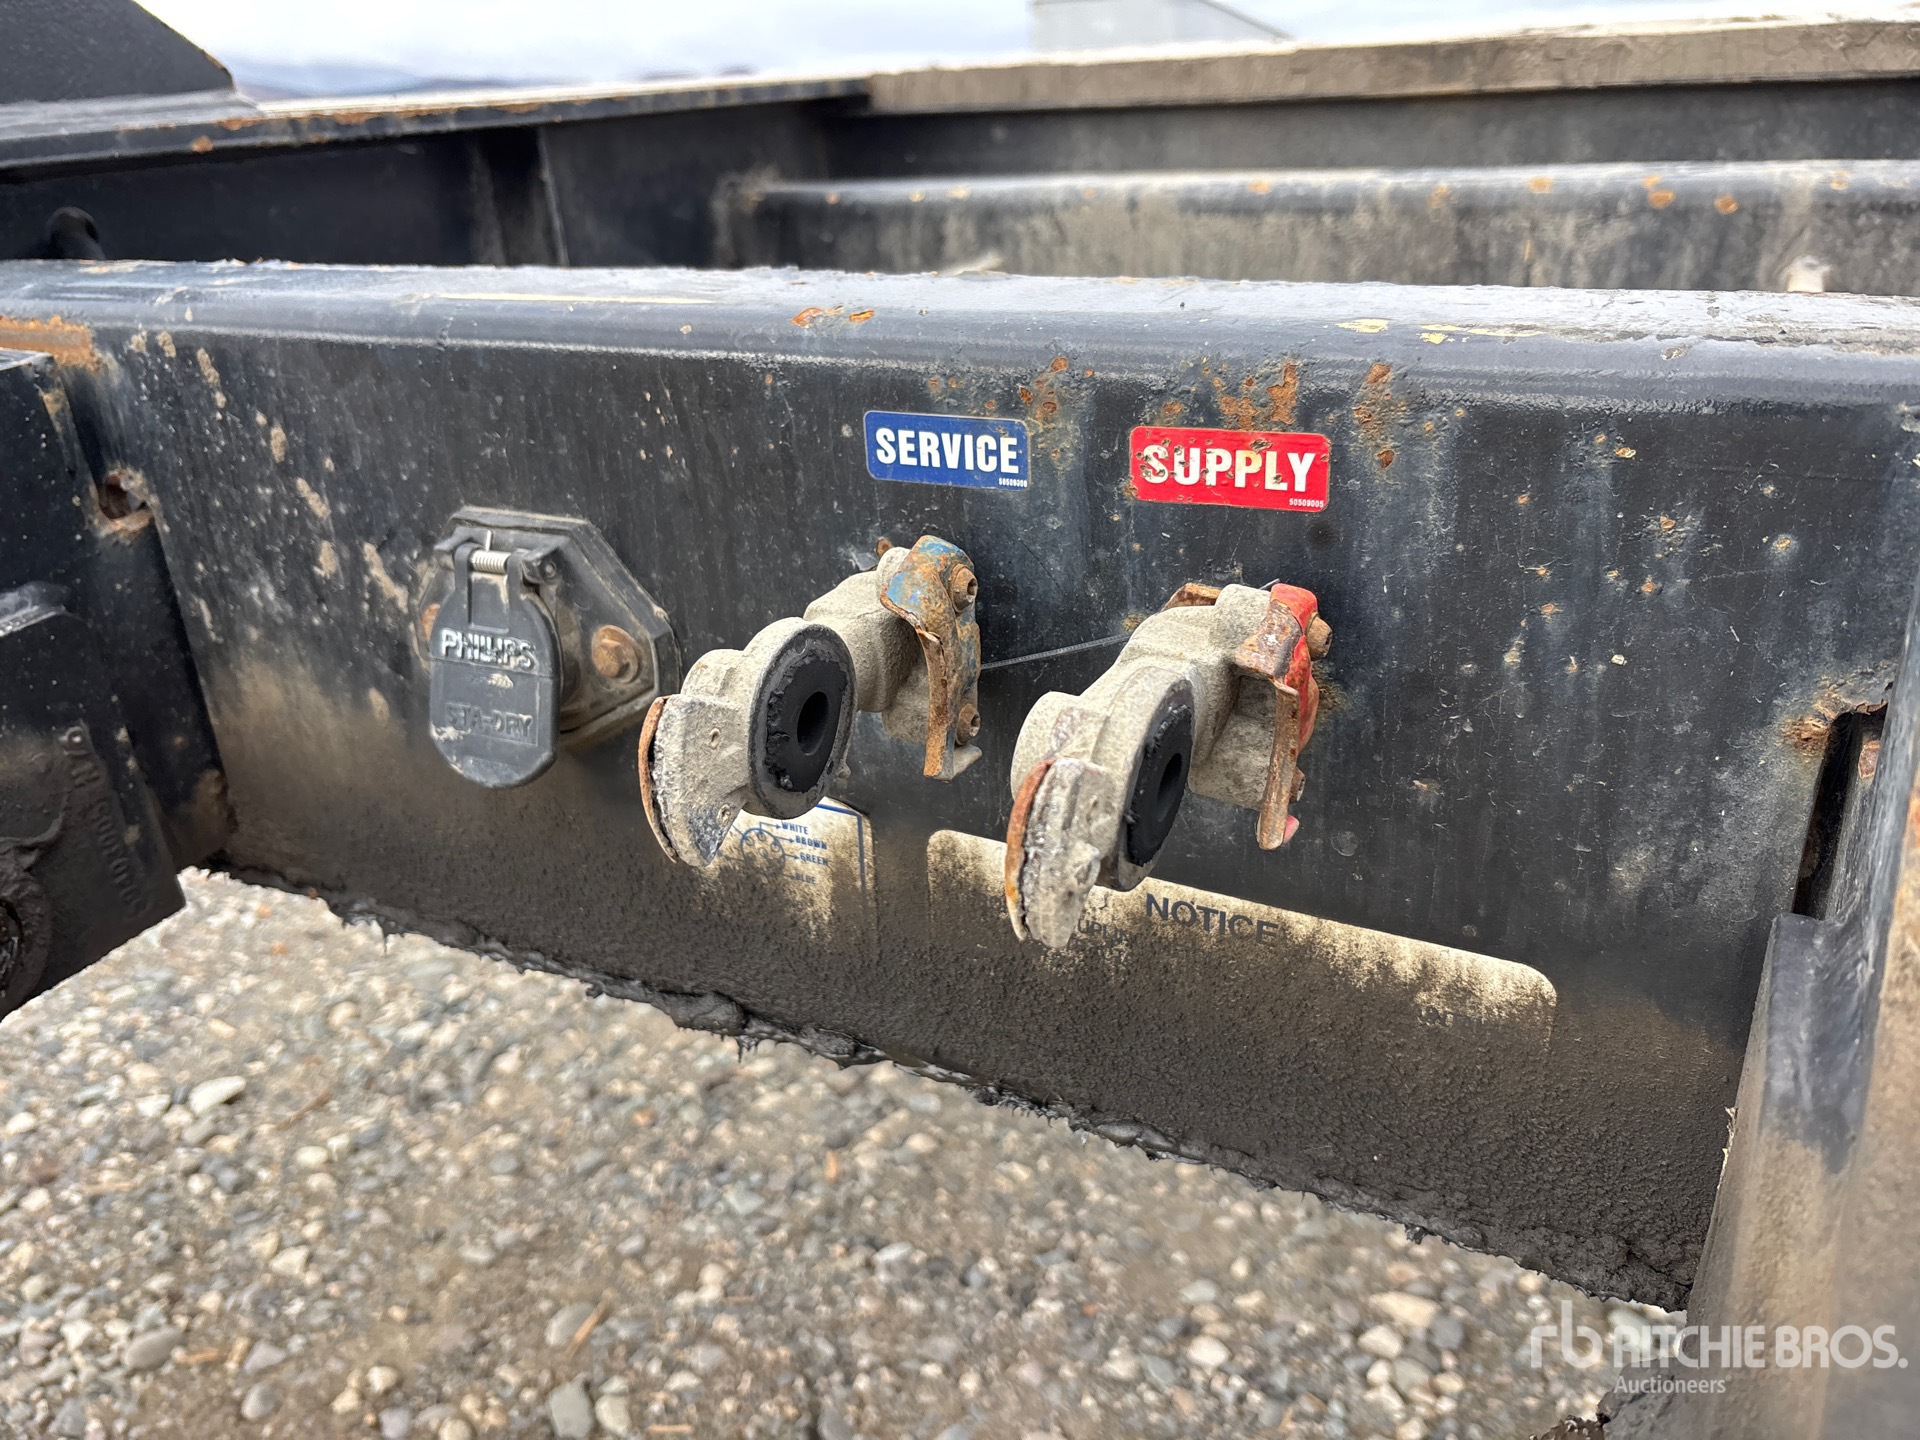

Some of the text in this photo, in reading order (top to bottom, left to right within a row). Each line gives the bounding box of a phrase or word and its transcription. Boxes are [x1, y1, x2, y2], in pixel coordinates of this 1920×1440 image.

[875, 427, 1020, 475] SERVICE
[1142, 444, 1316, 493] SUPPLY
[440, 626, 537, 671] PHILLIPS
[446, 703, 534, 736] STA-DRY
[781, 821, 808, 835] WHITE
[795, 835, 828, 850] BROWN
[800, 851, 829, 866] GREEN
[1145, 892, 1280, 946] NOTICE
